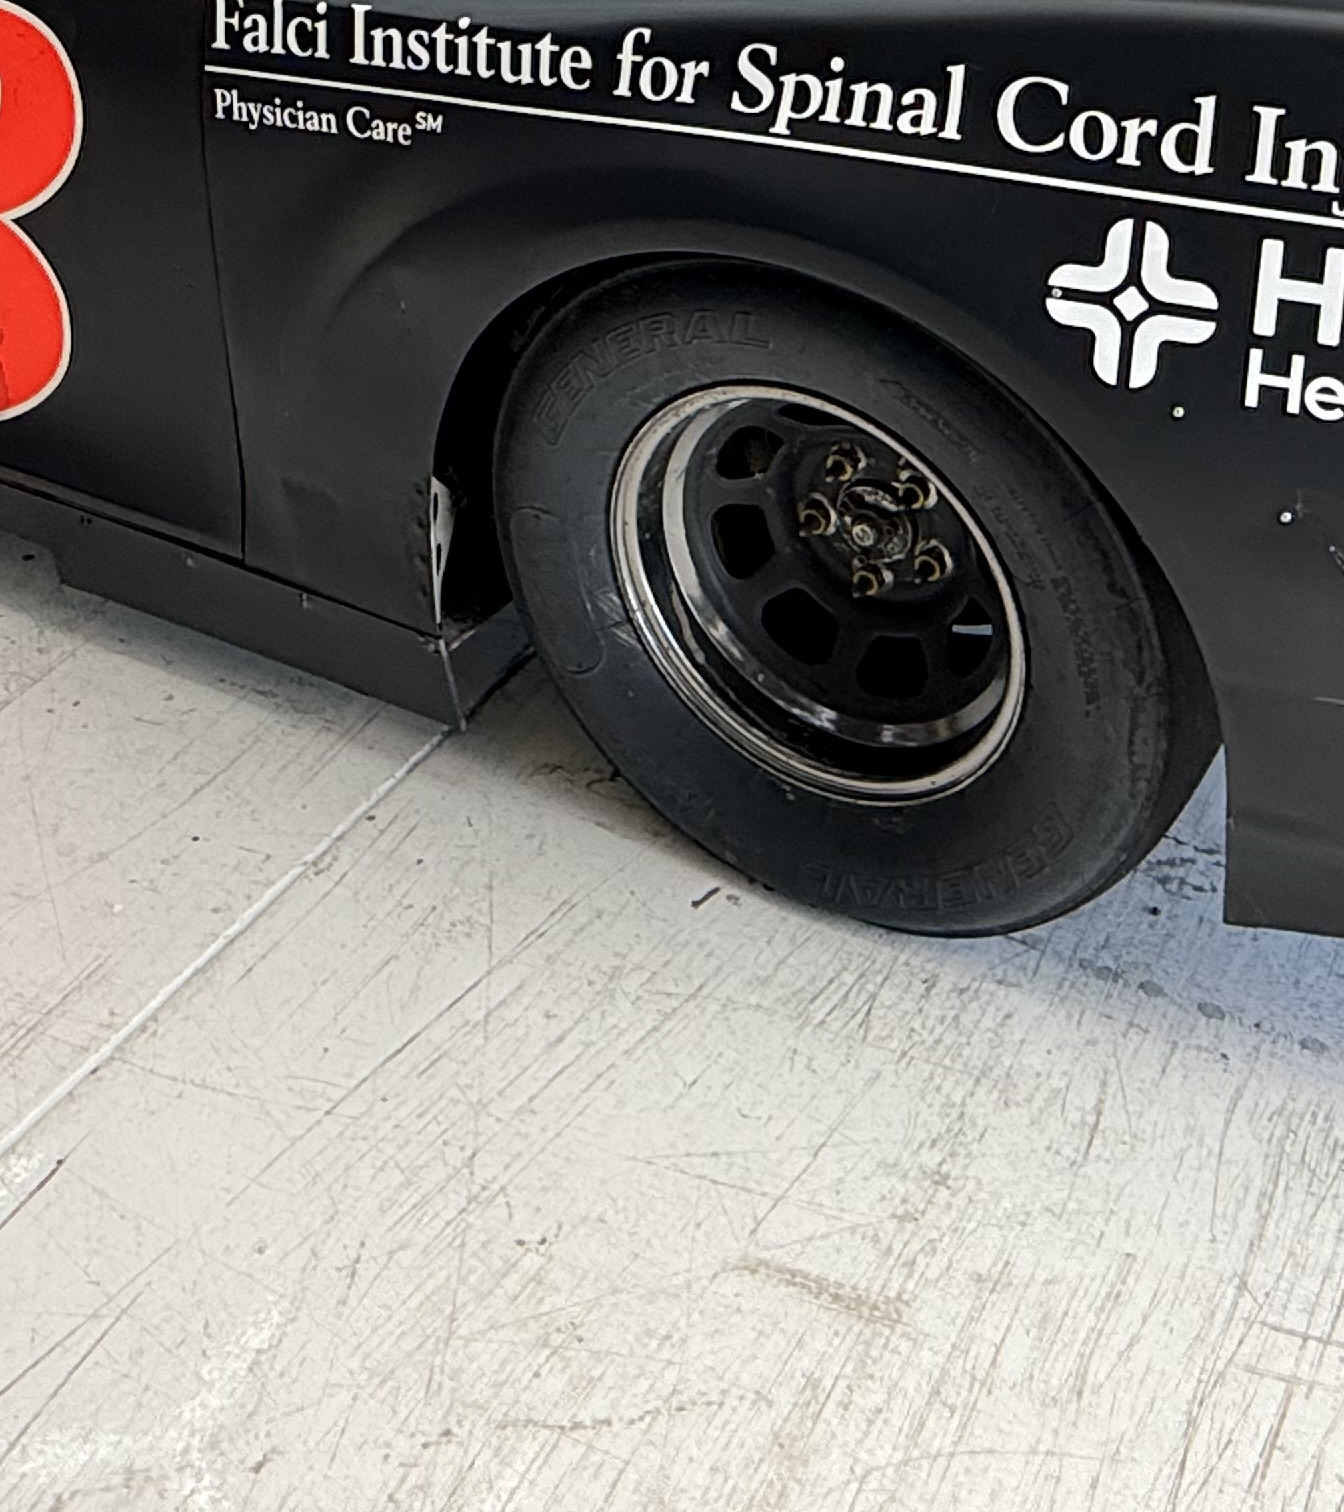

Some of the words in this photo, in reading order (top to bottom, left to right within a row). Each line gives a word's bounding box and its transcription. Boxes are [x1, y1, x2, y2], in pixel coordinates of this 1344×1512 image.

[213, 89, 338, 137] Physician
[348, 4, 593, 90] Institute
[612, 26, 710, 104] for
[729, 42, 968, 143] Spinal
[996, 76, 1218, 176] Cord
